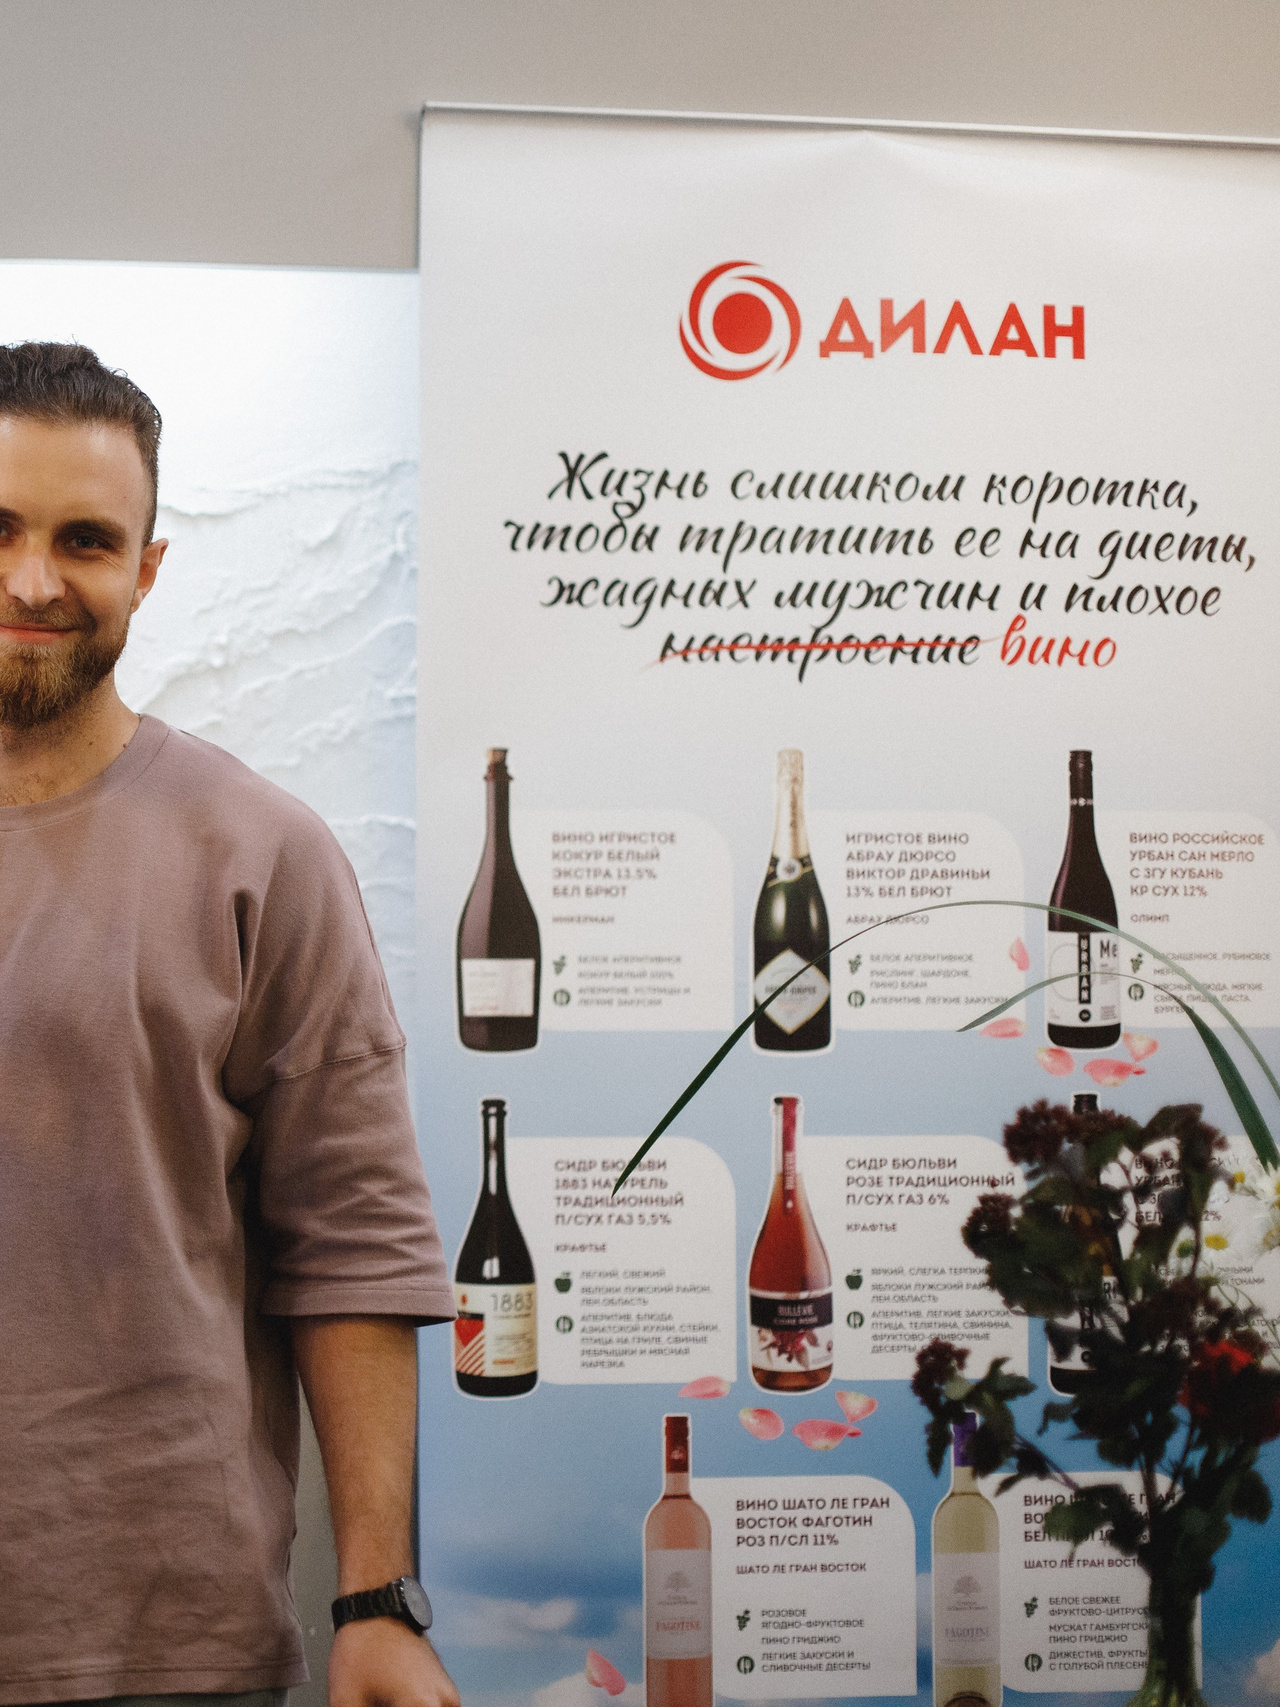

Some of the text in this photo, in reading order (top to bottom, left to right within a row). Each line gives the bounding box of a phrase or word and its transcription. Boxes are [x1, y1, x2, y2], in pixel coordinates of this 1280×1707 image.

[818, 297, 1086, 360] ДИЛАН
[548, 451, 1199, 523] Жизнь слишком коротка,
[504, 500, 1257, 581] чтобы тратить ее на диеты,
[540, 576, 1221, 630] жадных мужчин и плохое
[658, 614, 1117, 683] настроение вино
[552, 832, 676, 843] ВИНО ИГРИСТОЕ
[846, 833, 969, 844] ИГРИСТОЕ ВИНО
[1129, 830, 1265, 845] ВИНО РОССИЙСКОЕ
[552, 846, 660, 861] КОКУР БЕЛЫЙ
[846, 850, 956, 862] АБРАУ ДЮРСО
[1129, 850, 1255, 862] УРБАН САН МЕРЛО
[552, 867, 612, 879] ЭКСТРА
[846, 868, 990, 880] ВИКТОР ДРАВИНЬИ
[1129, 867, 1141, 879] С
[1170, 867, 1224, 879] КУБАНЬ
[552, 885, 627, 897] БЕЛ БРЮТ
[846, 886, 953, 897] 13% БЕЛ БРЮТ
[1130, 885, 1208, 896] КР СУХ 12%
[846, 915, 882, 924] АБРАУ
[1130, 914, 1169, 923] ОЛИМП
[554, 1159, 667, 1172] СИДР БЮЬВИ
[846, 1158, 957, 1170] СИДР БЮЛЬВИ
[554, 1178, 588, 1190] 1883
[846, 1172, 1015, 1187] РОЗЕ ТРАДИЦИОННЫЙ
[554, 1192, 684, 1208] ТРАДИЦИОННЫЙ
[846, 1193, 950, 1205] П/СУХ ГАЗ 6%
[554, 1213, 603, 1226] П/СУХ
[607, 1213, 634, 1226] ГАЗ
[846, 1222, 897, 1232] КРАФТЬЕ
[736, 1498, 890, 1511] ВИНО ШАТО ЛЕ ГРАН
[1024, 1494, 1065, 1506] ВИНО
[736, 1515, 873, 1529] ВОСТОК ФАГОТИН
[736, 1534, 839, 1547] РОЗ П/СЛ 11%
[736, 1562, 866, 1574] ШАТО ЛЕ ГРАН ВОСТОК
[1024, 1559, 1057, 1569] ШАТО
[1077, 1559, 1105, 1569] ГРАН
[1049, 1596, 1121, 1605] БЕЛОЕ СВЕЖЕЕ
[761, 1609, 807, 1618] РОЗОВОЕ
[761, 1636, 790, 1644] ПИНО
[1049, 1635, 1076, 1643] ПИНО
[761, 1651, 854, 1660] ЛЕГКИЕ ЗАКУСКИ И
[825, 1662, 871, 1671] ДЕСЕРТЫ
[1049, 1662, 1104, 1671] С ГОЛУБОЙ
